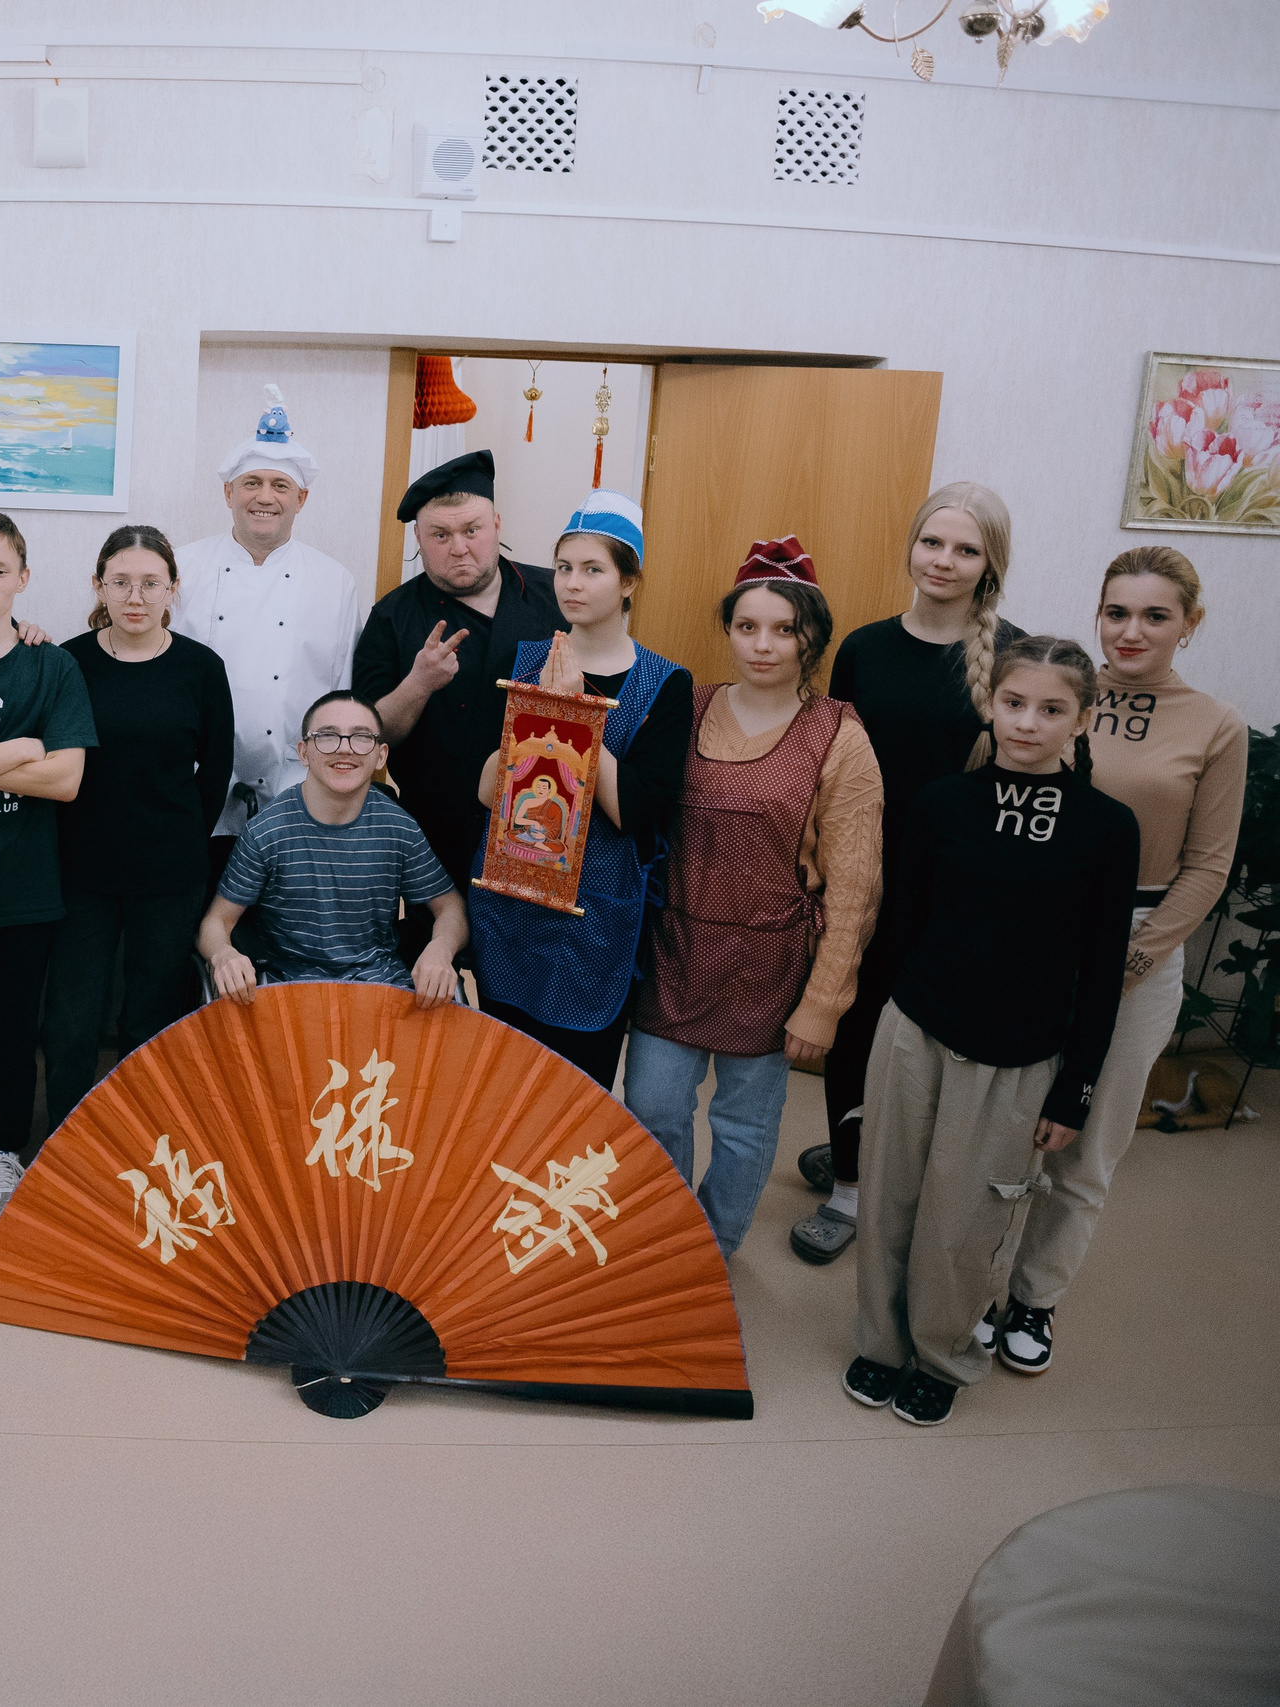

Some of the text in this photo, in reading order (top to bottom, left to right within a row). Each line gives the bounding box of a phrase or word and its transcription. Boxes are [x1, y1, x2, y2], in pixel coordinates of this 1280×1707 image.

[1093, 711, 1151, 742] ng
[995, 781, 1063, 814] wa
[995, 808, 1057, 842] ng
[1126, 957, 1146, 977] ng
[1133, 948, 1154, 969] wa
